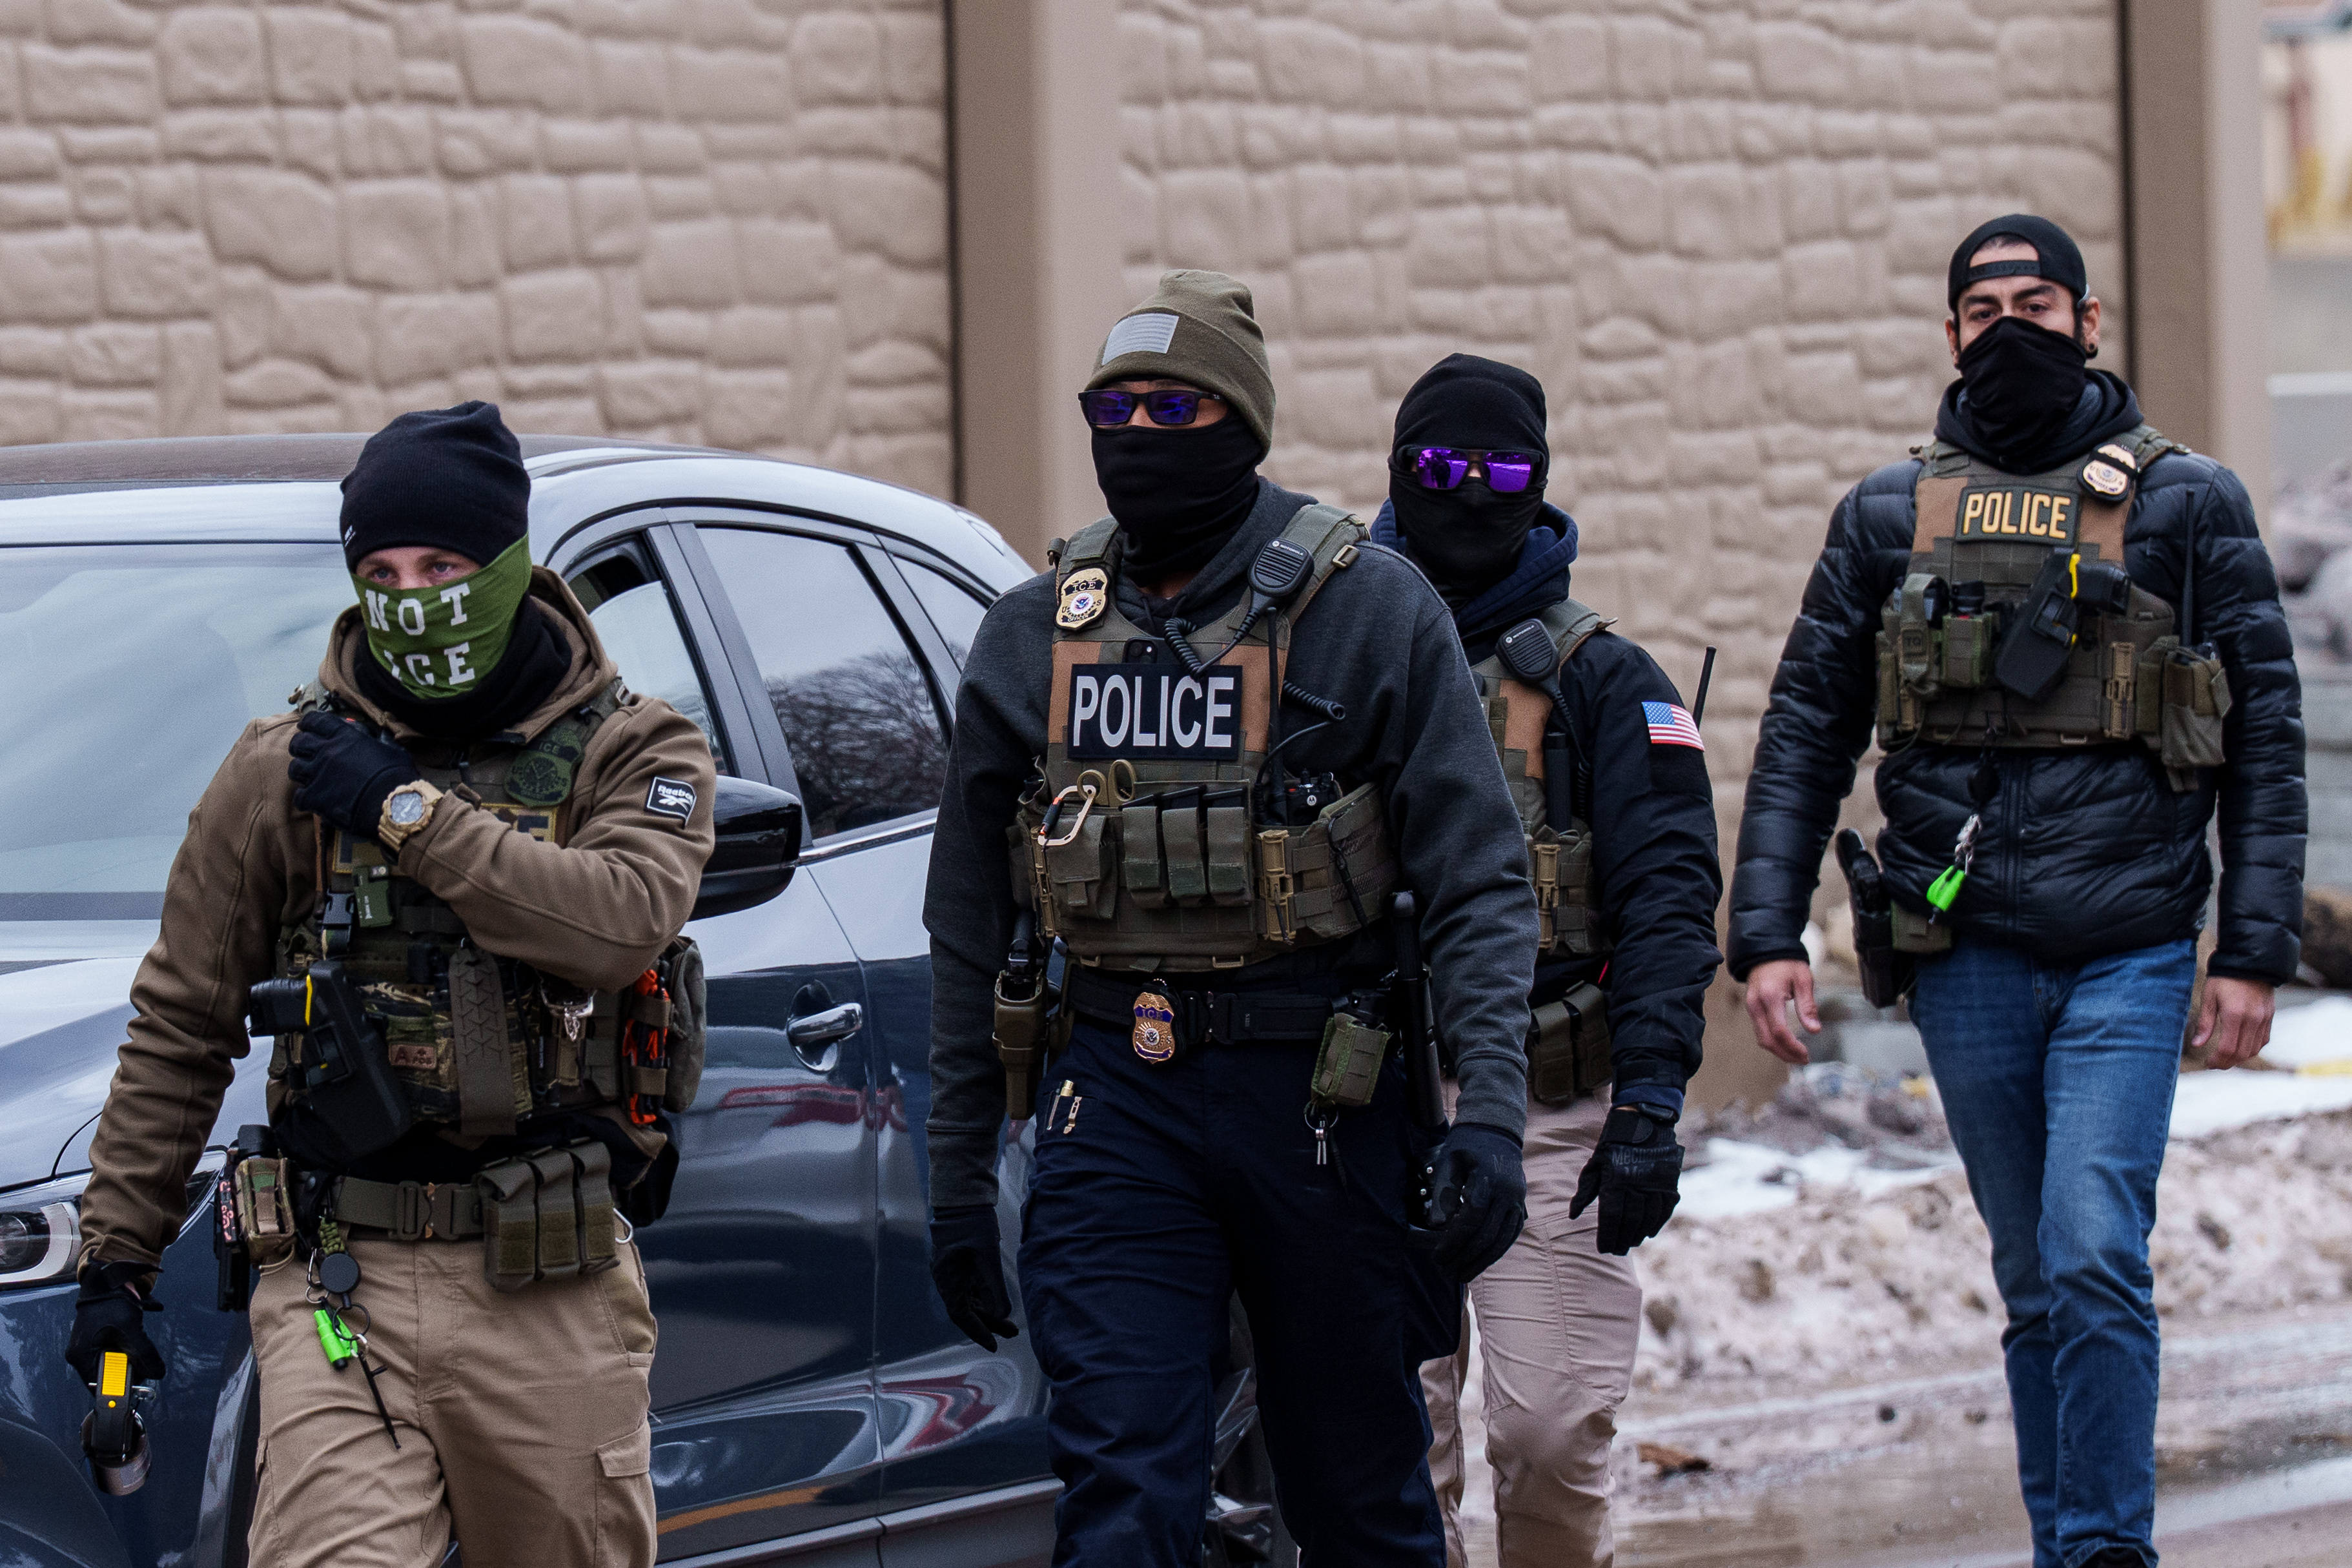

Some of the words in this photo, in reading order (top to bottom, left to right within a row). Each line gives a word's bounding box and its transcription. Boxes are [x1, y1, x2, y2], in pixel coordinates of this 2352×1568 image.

[1963, 491, 2071, 540] POLICE
[365, 582, 471, 635] NOT
[1072, 581, 1096, 593] ICE
[1073, 675, 1234, 748] POLICE
[1141, 1009, 1163, 1020] ICE
